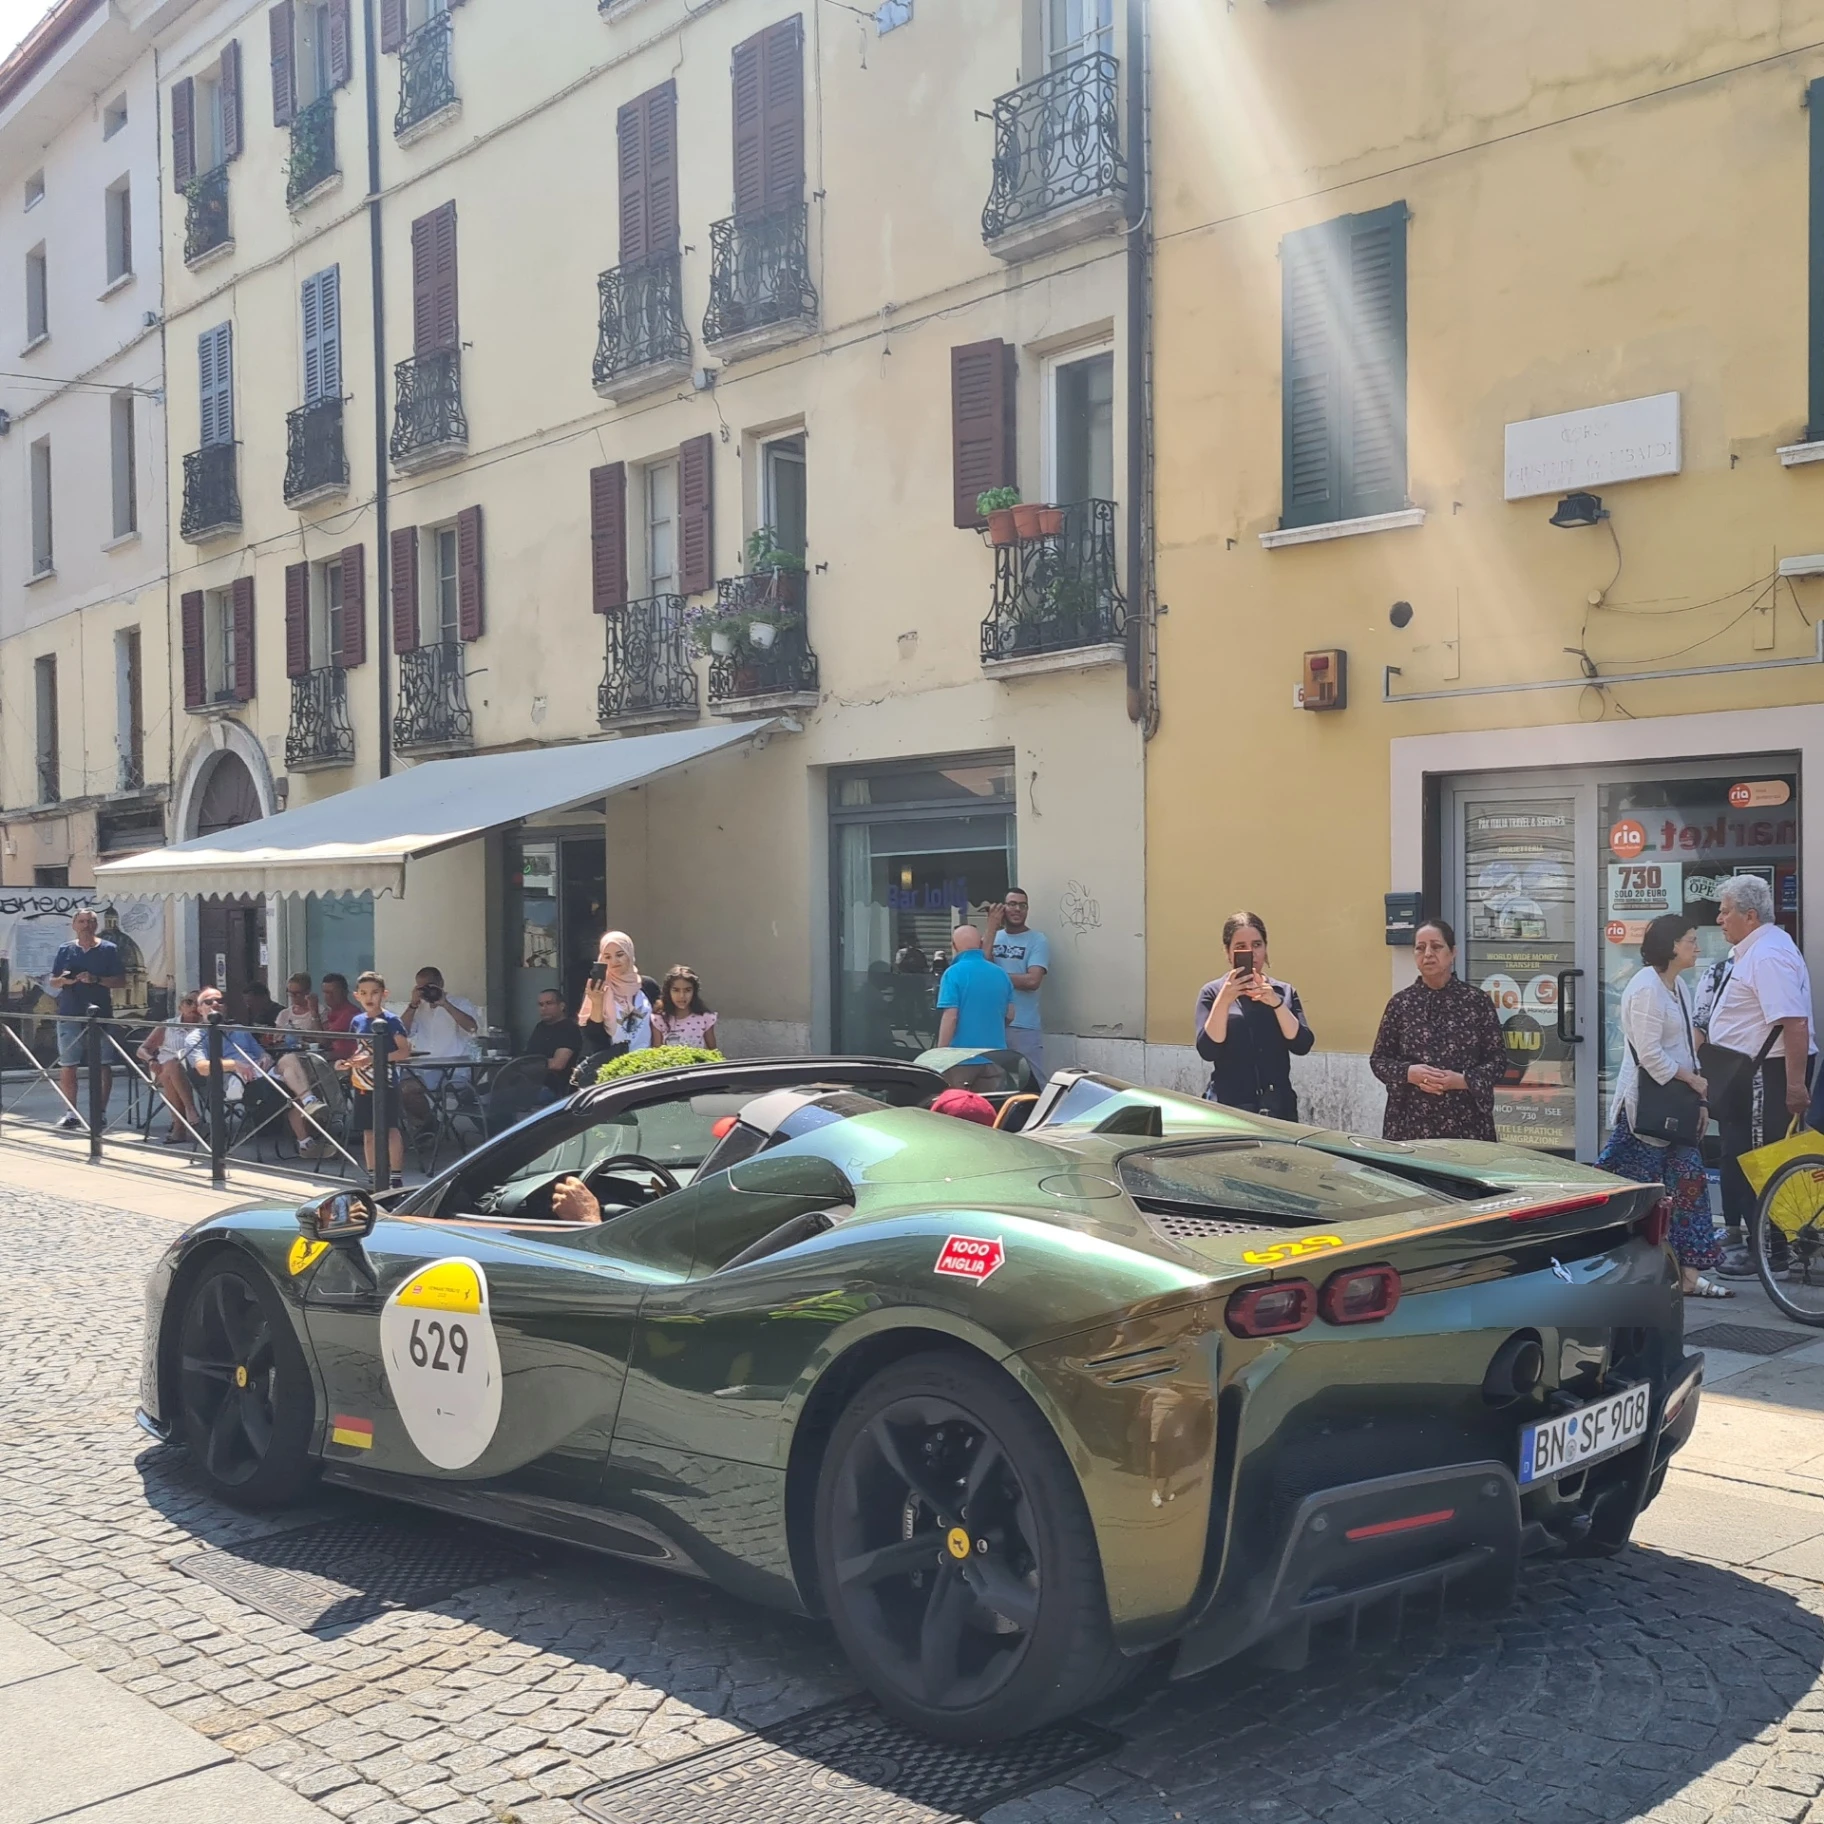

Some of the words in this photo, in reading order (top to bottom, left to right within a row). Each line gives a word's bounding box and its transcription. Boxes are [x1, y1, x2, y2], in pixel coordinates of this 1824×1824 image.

[1731, 787, 1749, 800] ria
[1614, 825, 1641, 844] ria
[1618, 866, 1662, 889] 730
[1614, 890, 1633, 898] SOLO
[1635, 889, 1645, 897] 20
[1647, 889, 1667, 897] EURO
[1689, 882, 1720, 897] OPE
[1608, 923, 1624, 934] ria
[1487, 953, 1511, 961] WORLD
[1513, 953, 1531, 961] WIDE
[1532, 953, 1558, 961] MONEY
[1505, 961, 1540, 969] TRANSFER
[1527, 1007, 1557, 1015] MoneyGra
[1493, 1105, 1513, 1113] NICO
[1544, 1108, 1562, 1116] ISEE
[1521, 1112, 1537, 1120] 730
[1512, 1125, 1522, 1133] LE
[1524, 1126, 1564, 1136] PRATICHE
[952, 1241, 990, 1256] 1000
[1243, 1235, 1343, 1263] 629
[941, 1256, 985, 1273] MIGLIA
[409, 1319, 469, 1374] 629
[1535, 1423, 1566, 1473] BN
[1580, 1406, 1607, 1453] SF
[1612, 1391, 1646, 1440] 908
